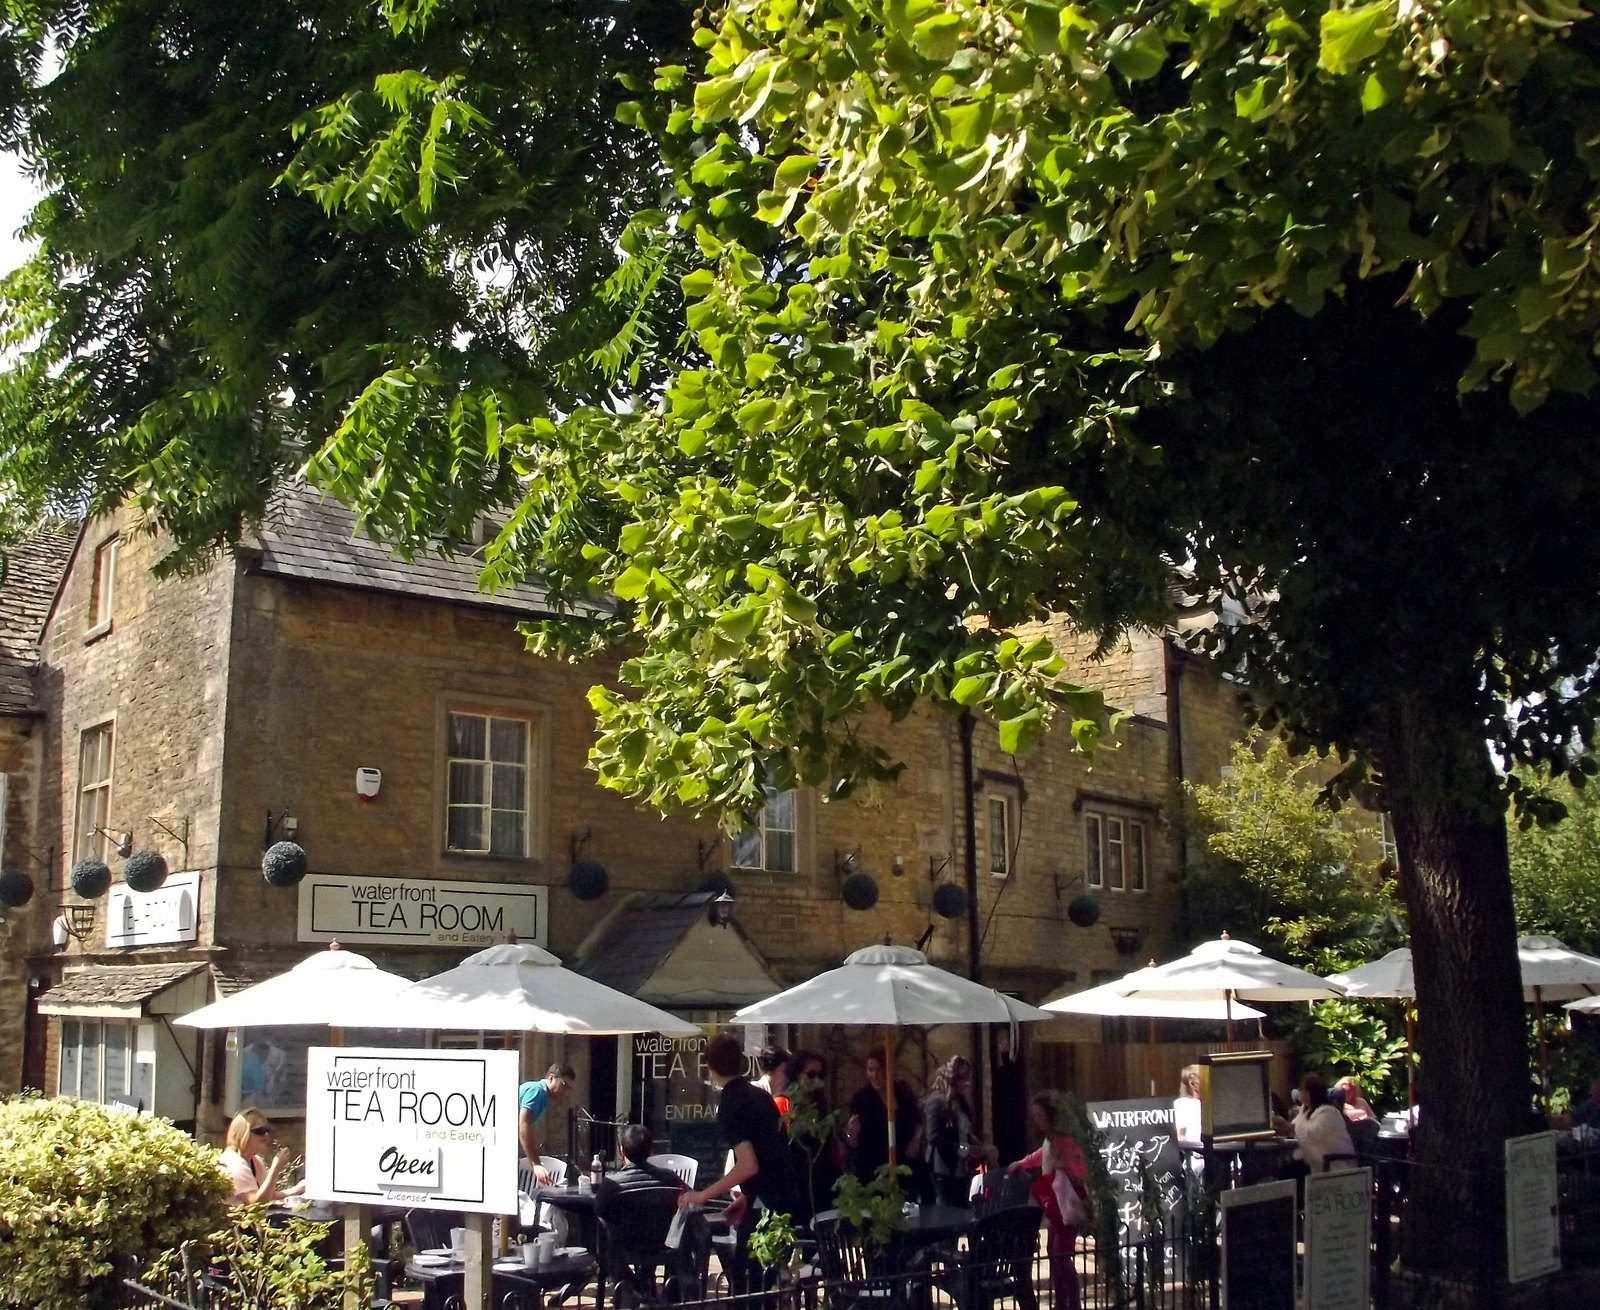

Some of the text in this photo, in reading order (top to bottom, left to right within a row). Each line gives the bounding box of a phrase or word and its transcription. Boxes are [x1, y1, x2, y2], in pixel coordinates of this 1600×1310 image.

[351, 883, 436, 902] waterfront
[351, 900, 504, 932] TEA ROOM
[438, 933, 495, 944] and Eatery
[636, 1036, 708, 1052] waterfron
[636, 1053, 686, 1079] TEA
[326, 1067, 416, 1090] waterfront
[326, 1089, 496, 1127] TEA ROOM
[1092, 1108, 1175, 1128] WATERFRONT
[425, 1130, 486, 1143] and Eatery
[378, 1146, 435, 1180] Open
[387, 1191, 428, 1203] Licensed
